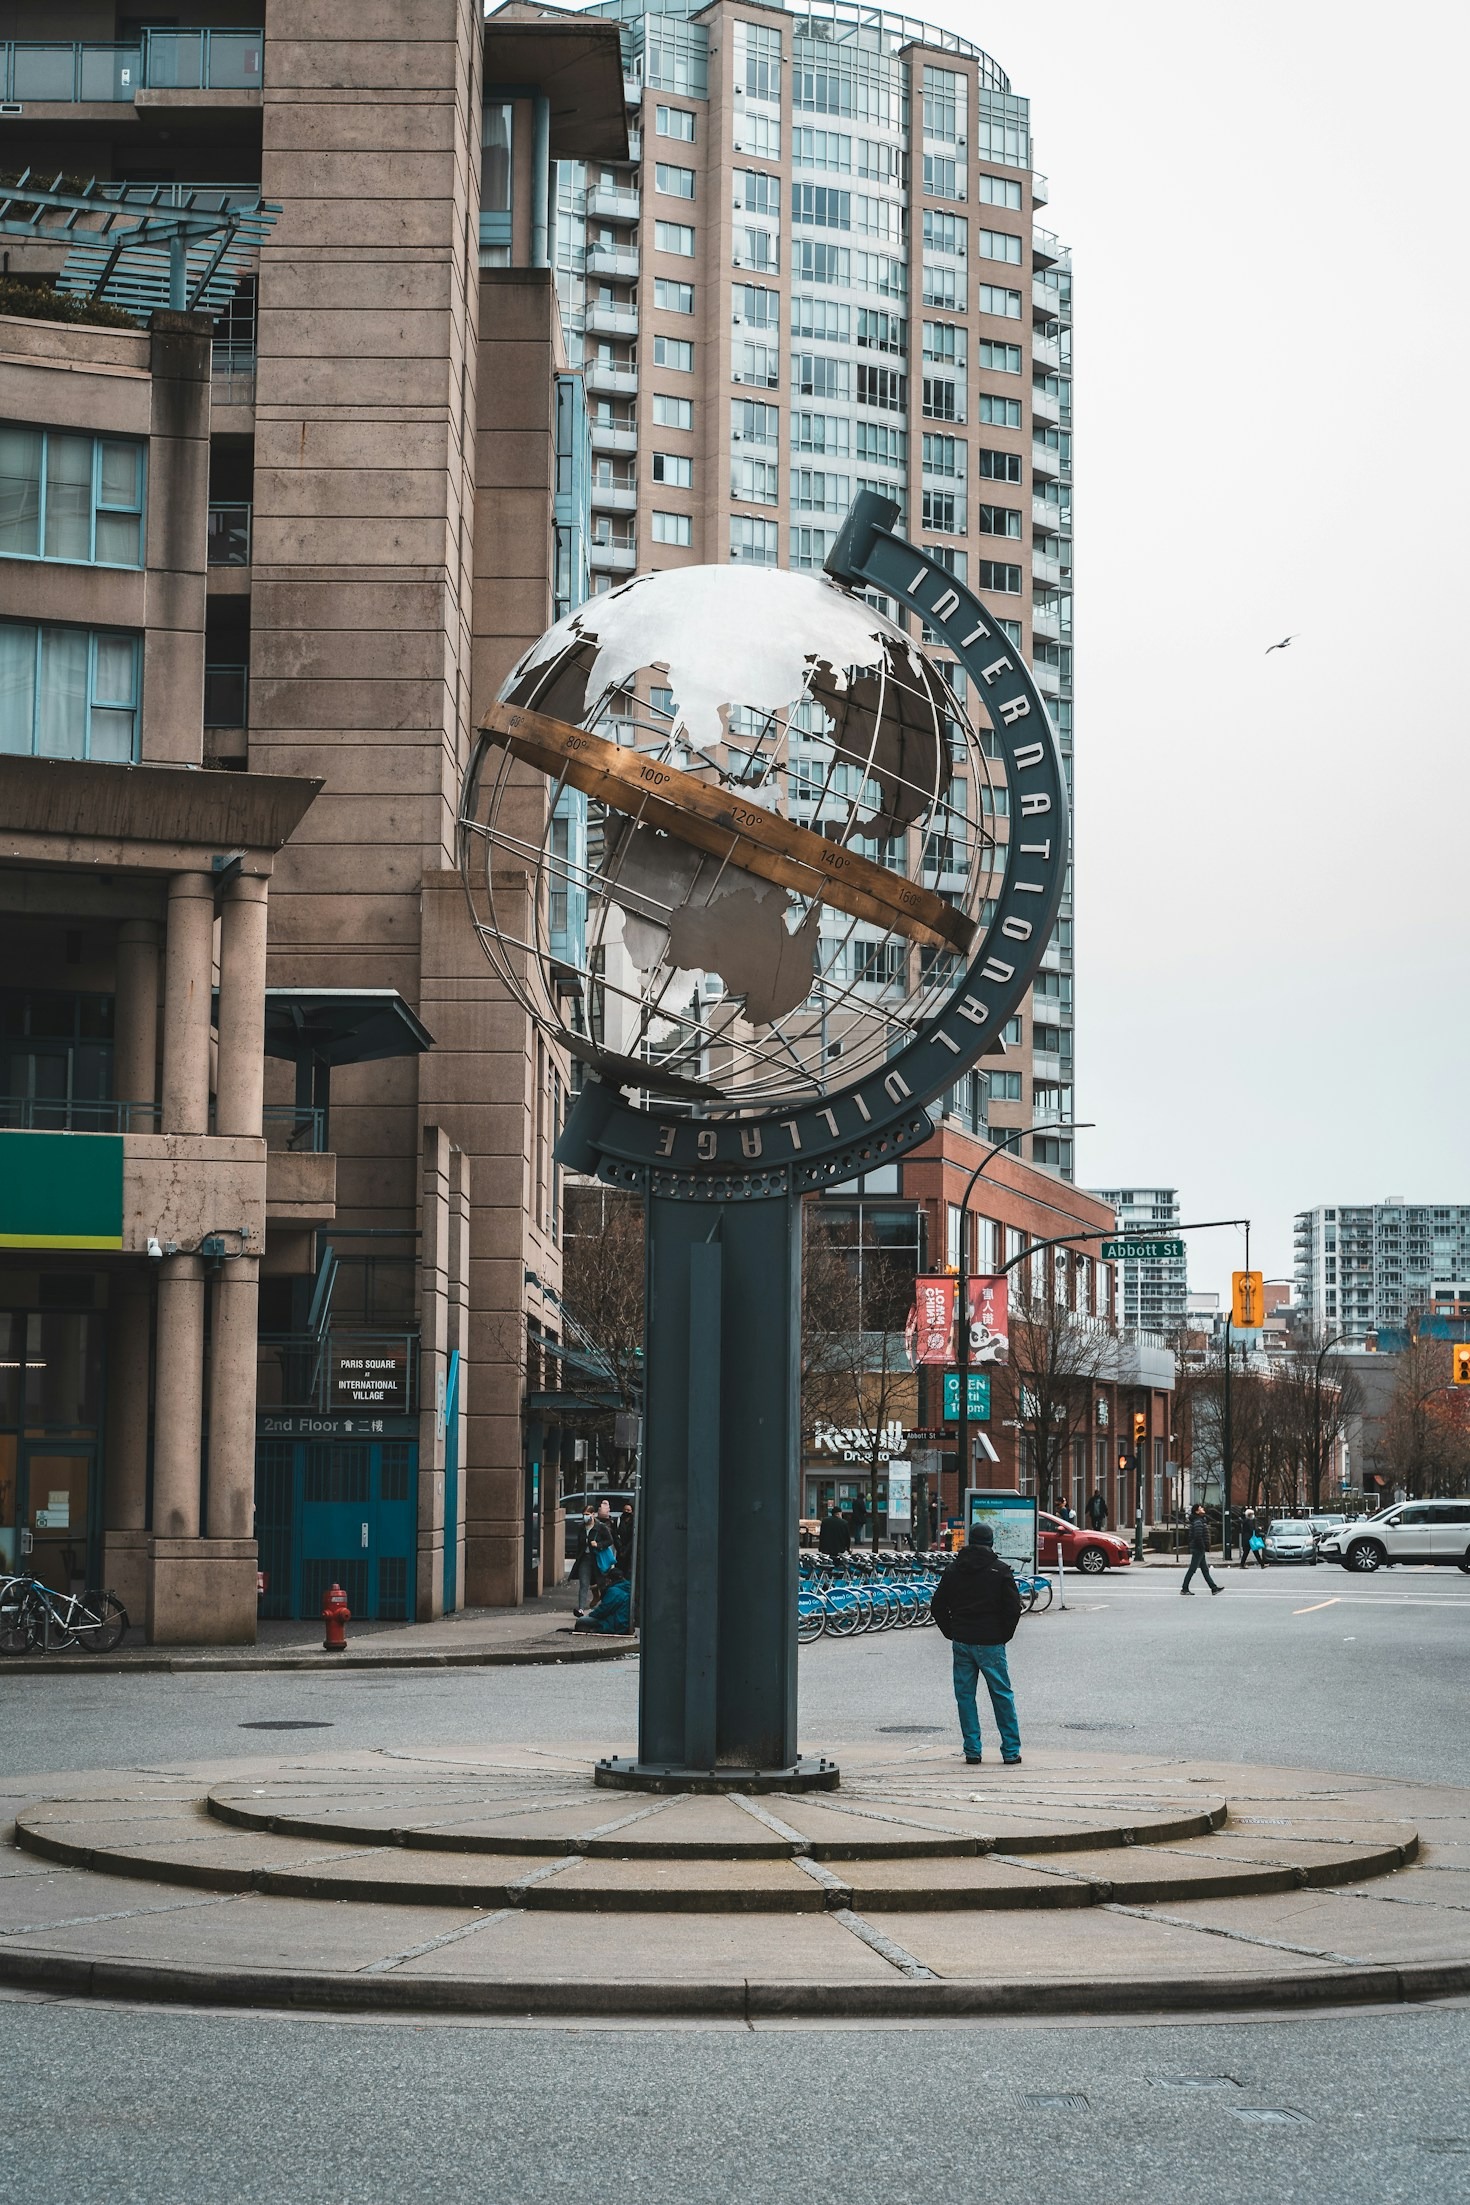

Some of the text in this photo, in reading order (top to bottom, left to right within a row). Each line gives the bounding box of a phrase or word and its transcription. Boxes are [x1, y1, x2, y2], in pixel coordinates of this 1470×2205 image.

[566, 735, 587, 750] 80°
[640, 766, 670, 785] 100°
[730, 806, 763, 828] 120°
[655, 566, 1051, 1161] INTERNATIONAL VILLAGE
[819, 849, 850, 869] 140°
[898, 887, 922, 906] 160°
[1107, 1243, 1178, 1257] Abbott St
[340, 1359, 396, 1369] PARIS SQUARE
[338, 1380, 398, 1390] INTERNATIONAL
[948, 1379, 986, 1390] OEN
[352, 1391, 384, 1400] VILLAGE
[950, 1402, 985, 1415] 1pm
[264, 1418, 339, 1431] 2nd Floor
